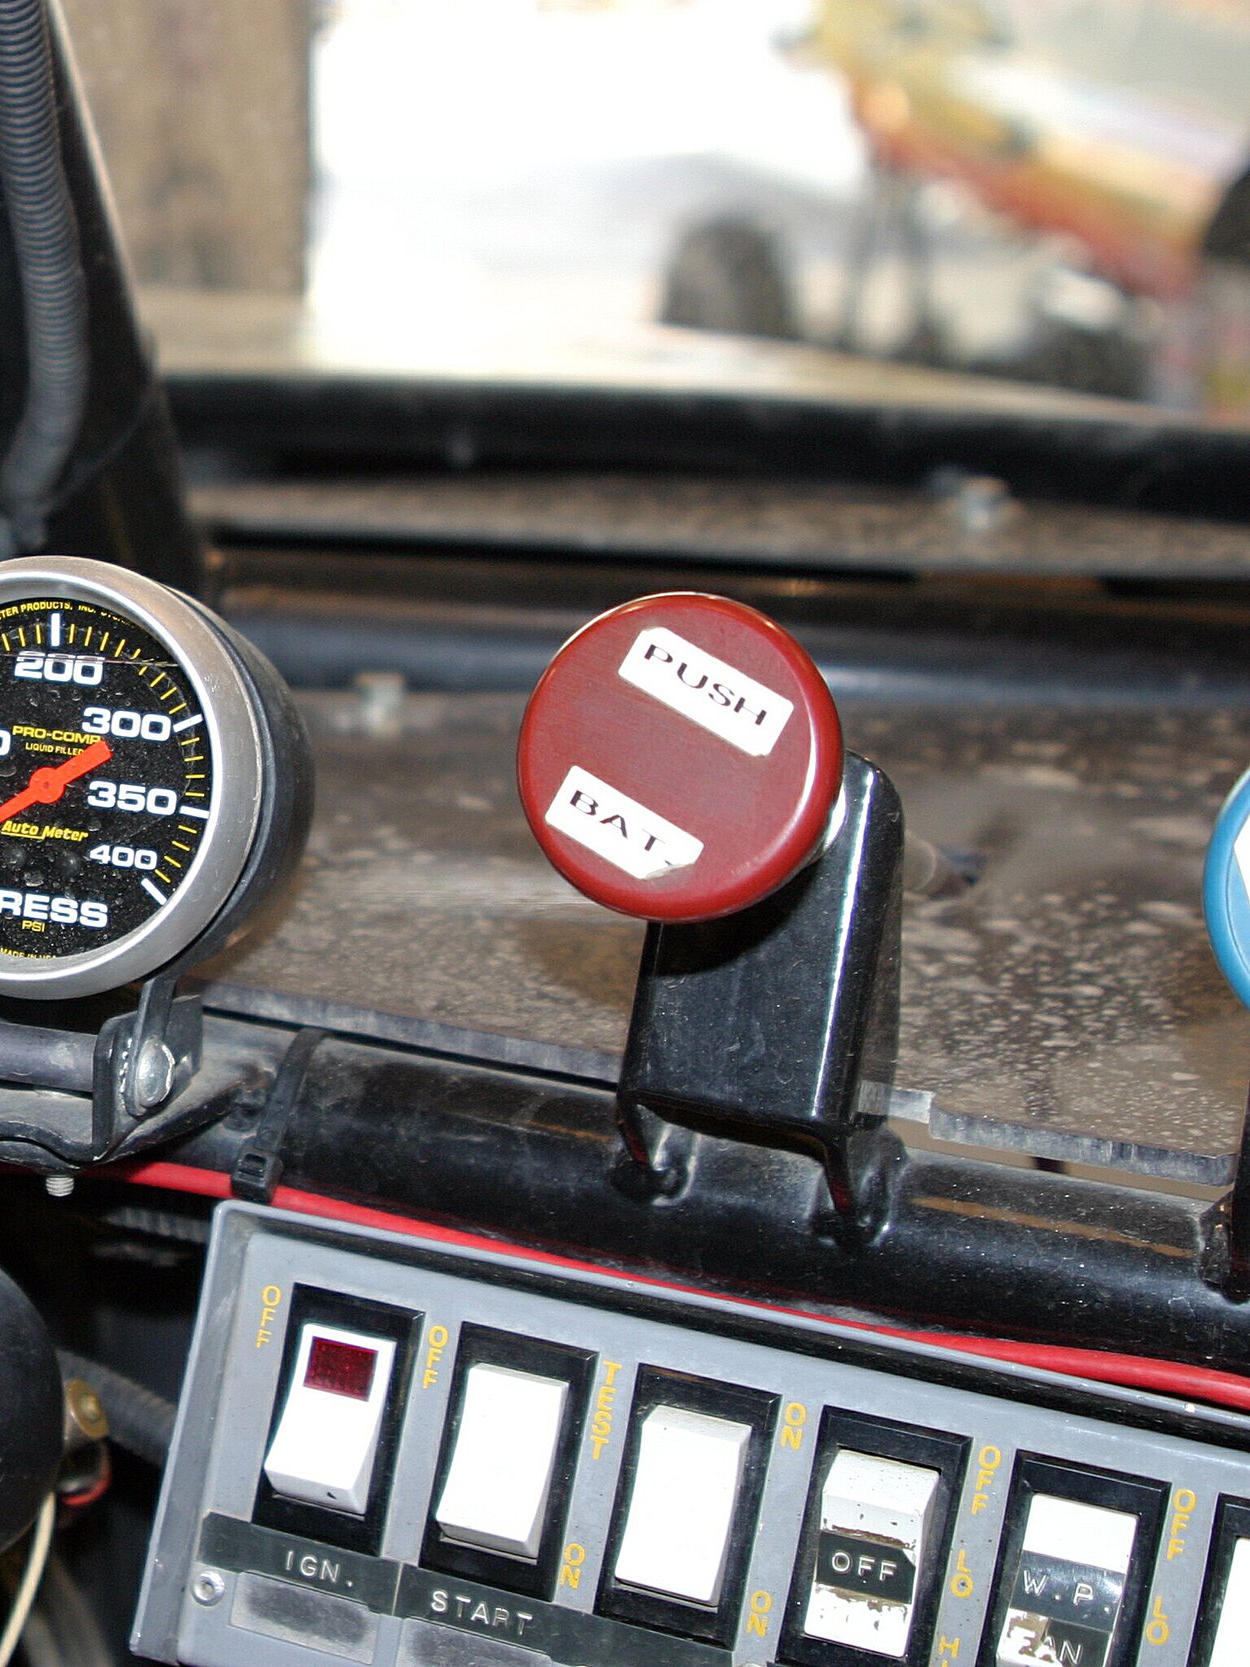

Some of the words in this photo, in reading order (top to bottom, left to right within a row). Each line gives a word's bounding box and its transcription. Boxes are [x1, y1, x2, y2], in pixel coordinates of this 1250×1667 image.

[13, 650, 106, 686] 200
[643, 643, 768, 726] PUSH
[11, 725, 102, 745] PRO-COMP
[82, 707, 172, 741] 300
[25, 742, 54, 754] LIQUID
[87, 780, 178, 815] 350
[1, 820, 44, 841] Auto
[43, 824, 88, 842] Meter
[89, 846, 158, 871] 400
[21, 920, 46, 932] PSI
[256, 1285, 281, 1348] OFF
[422, 1324, 448, 1390] OFF
[592, 1360, 622, 1460] TEST
[780, 1402, 807, 1451] ON
[972, 1446, 1001, 1515] OFF
[1167, 1488, 1196, 1560] OFF
[286, 1550, 354, 1588] IGN.
[560, 1543, 585, 1588] ON
[831, 1551, 897, 1582] OFF
[951, 1549, 974, 1599] LO
[432, 1591, 533, 1635] START
[746, 1590, 772, 1638] ON
[1146, 1596, 1169, 1646] LO
